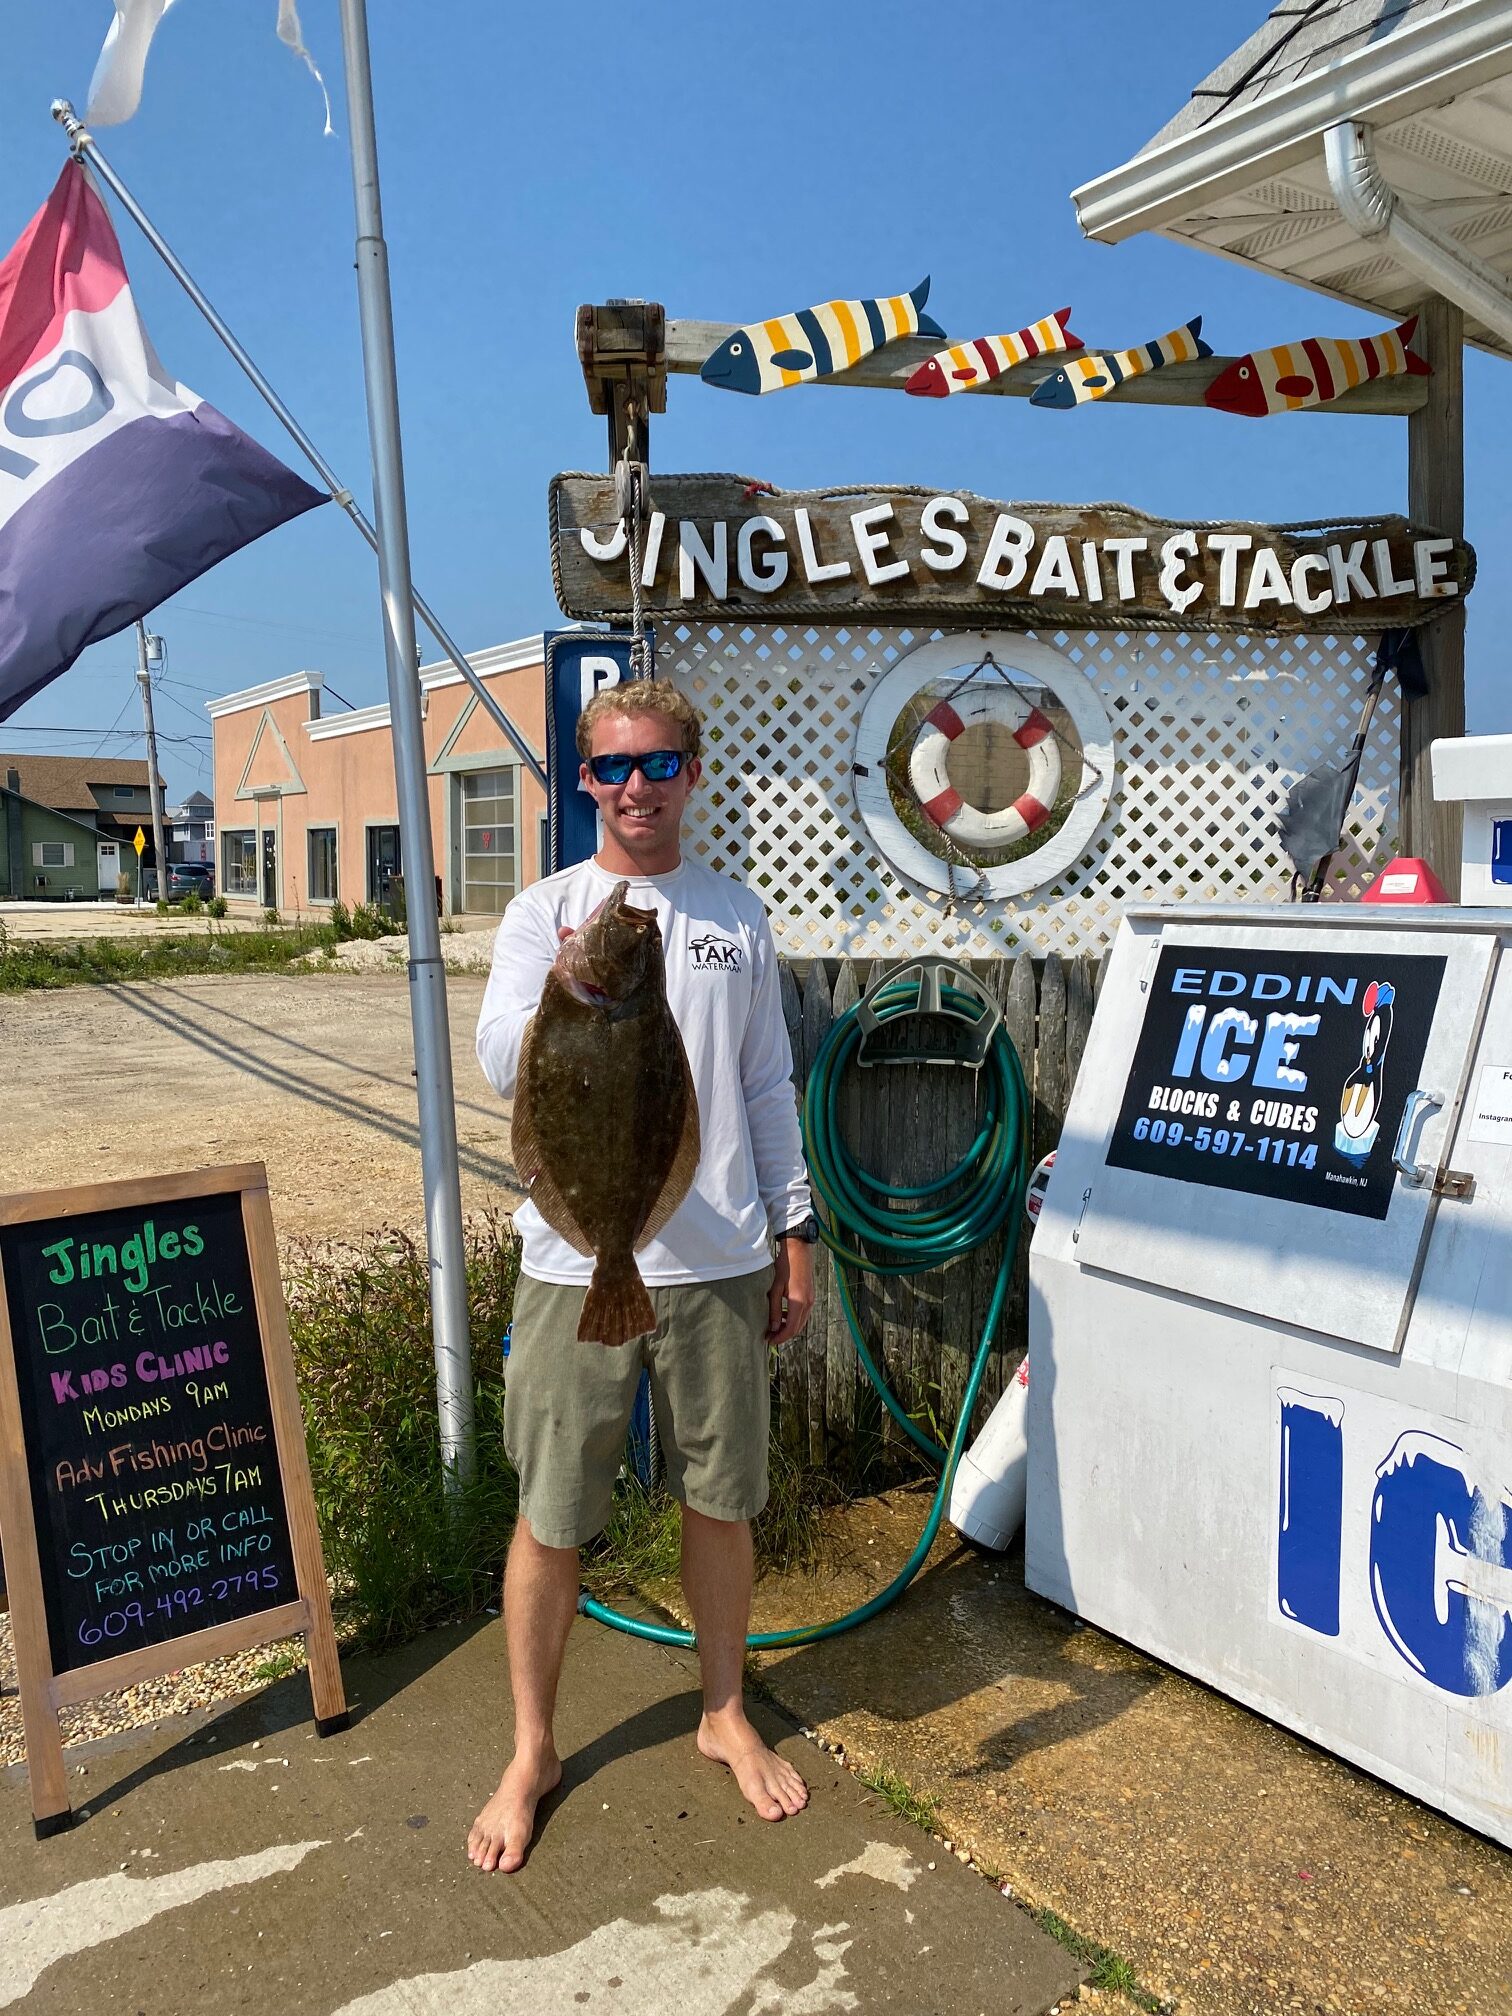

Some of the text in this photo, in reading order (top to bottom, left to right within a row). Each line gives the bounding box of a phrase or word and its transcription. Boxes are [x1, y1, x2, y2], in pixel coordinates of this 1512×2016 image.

[580, 497, 1459, 615] JINGLES BAIT & TACKLE
[688, 945, 738, 965] TAK
[692, 963, 742, 973] WATERMAN
[1171, 969, 1358, 1006] EDDIN
[1171, 1003, 1322, 1093] ICE
[1148, 1086, 1319, 1134] BLOCKS & CUBES
[1133, 1117, 1319, 1170] 609-597-1114
[42, 1220, 204, 1293] Jingles
[37, 1293, 121, 1354] Bait
[143, 1279, 243, 1332] Tackle
[50, 1341, 230, 1404] KIDS CLINIC
[82, 1381, 229, 1435] MONDAYS 9AM
[55, 1422, 267, 1492] Adv Fishing Clinic
[86, 1463, 262, 1523] THURSDAYS 7AM
[67, 1506, 274, 1578] STOP IN OR CALL
[95, 1534, 272, 1603] FOR MORE INFO
[78, 1564, 279, 1645] 609-492-2795
